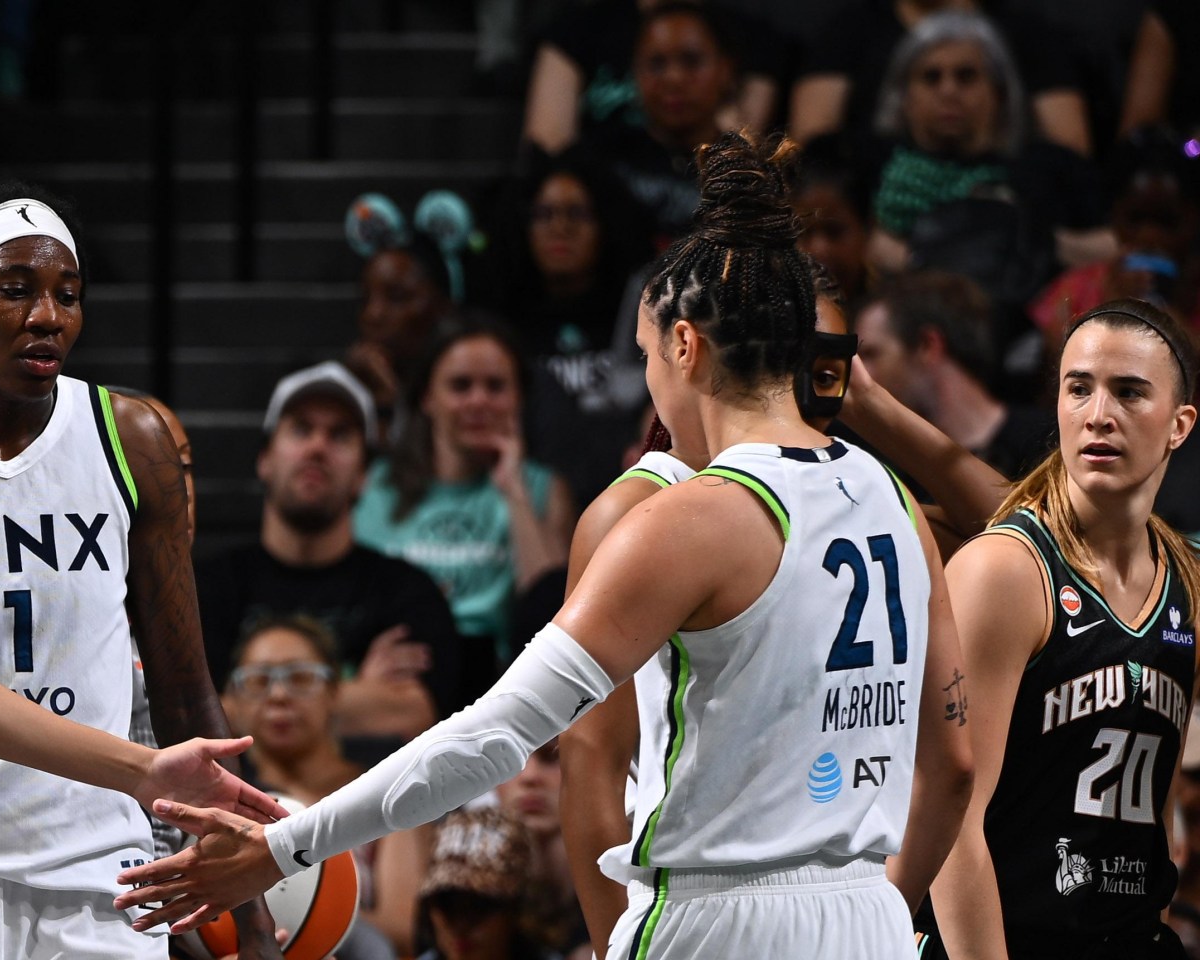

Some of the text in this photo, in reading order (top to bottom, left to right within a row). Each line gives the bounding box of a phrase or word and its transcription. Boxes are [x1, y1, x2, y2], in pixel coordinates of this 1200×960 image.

[3, 589, 34, 673] 1
[821, 533, 908, 673] 21
[1162, 630, 1193, 645] BARCLAYS
[822, 680, 906, 732] McBRIDE
[1042, 664, 1126, 735] NEW
[1074, 728, 1164, 825] 20
[1098, 876, 1146, 895] Mutual
[1100, 856, 1147, 876] Liberty
